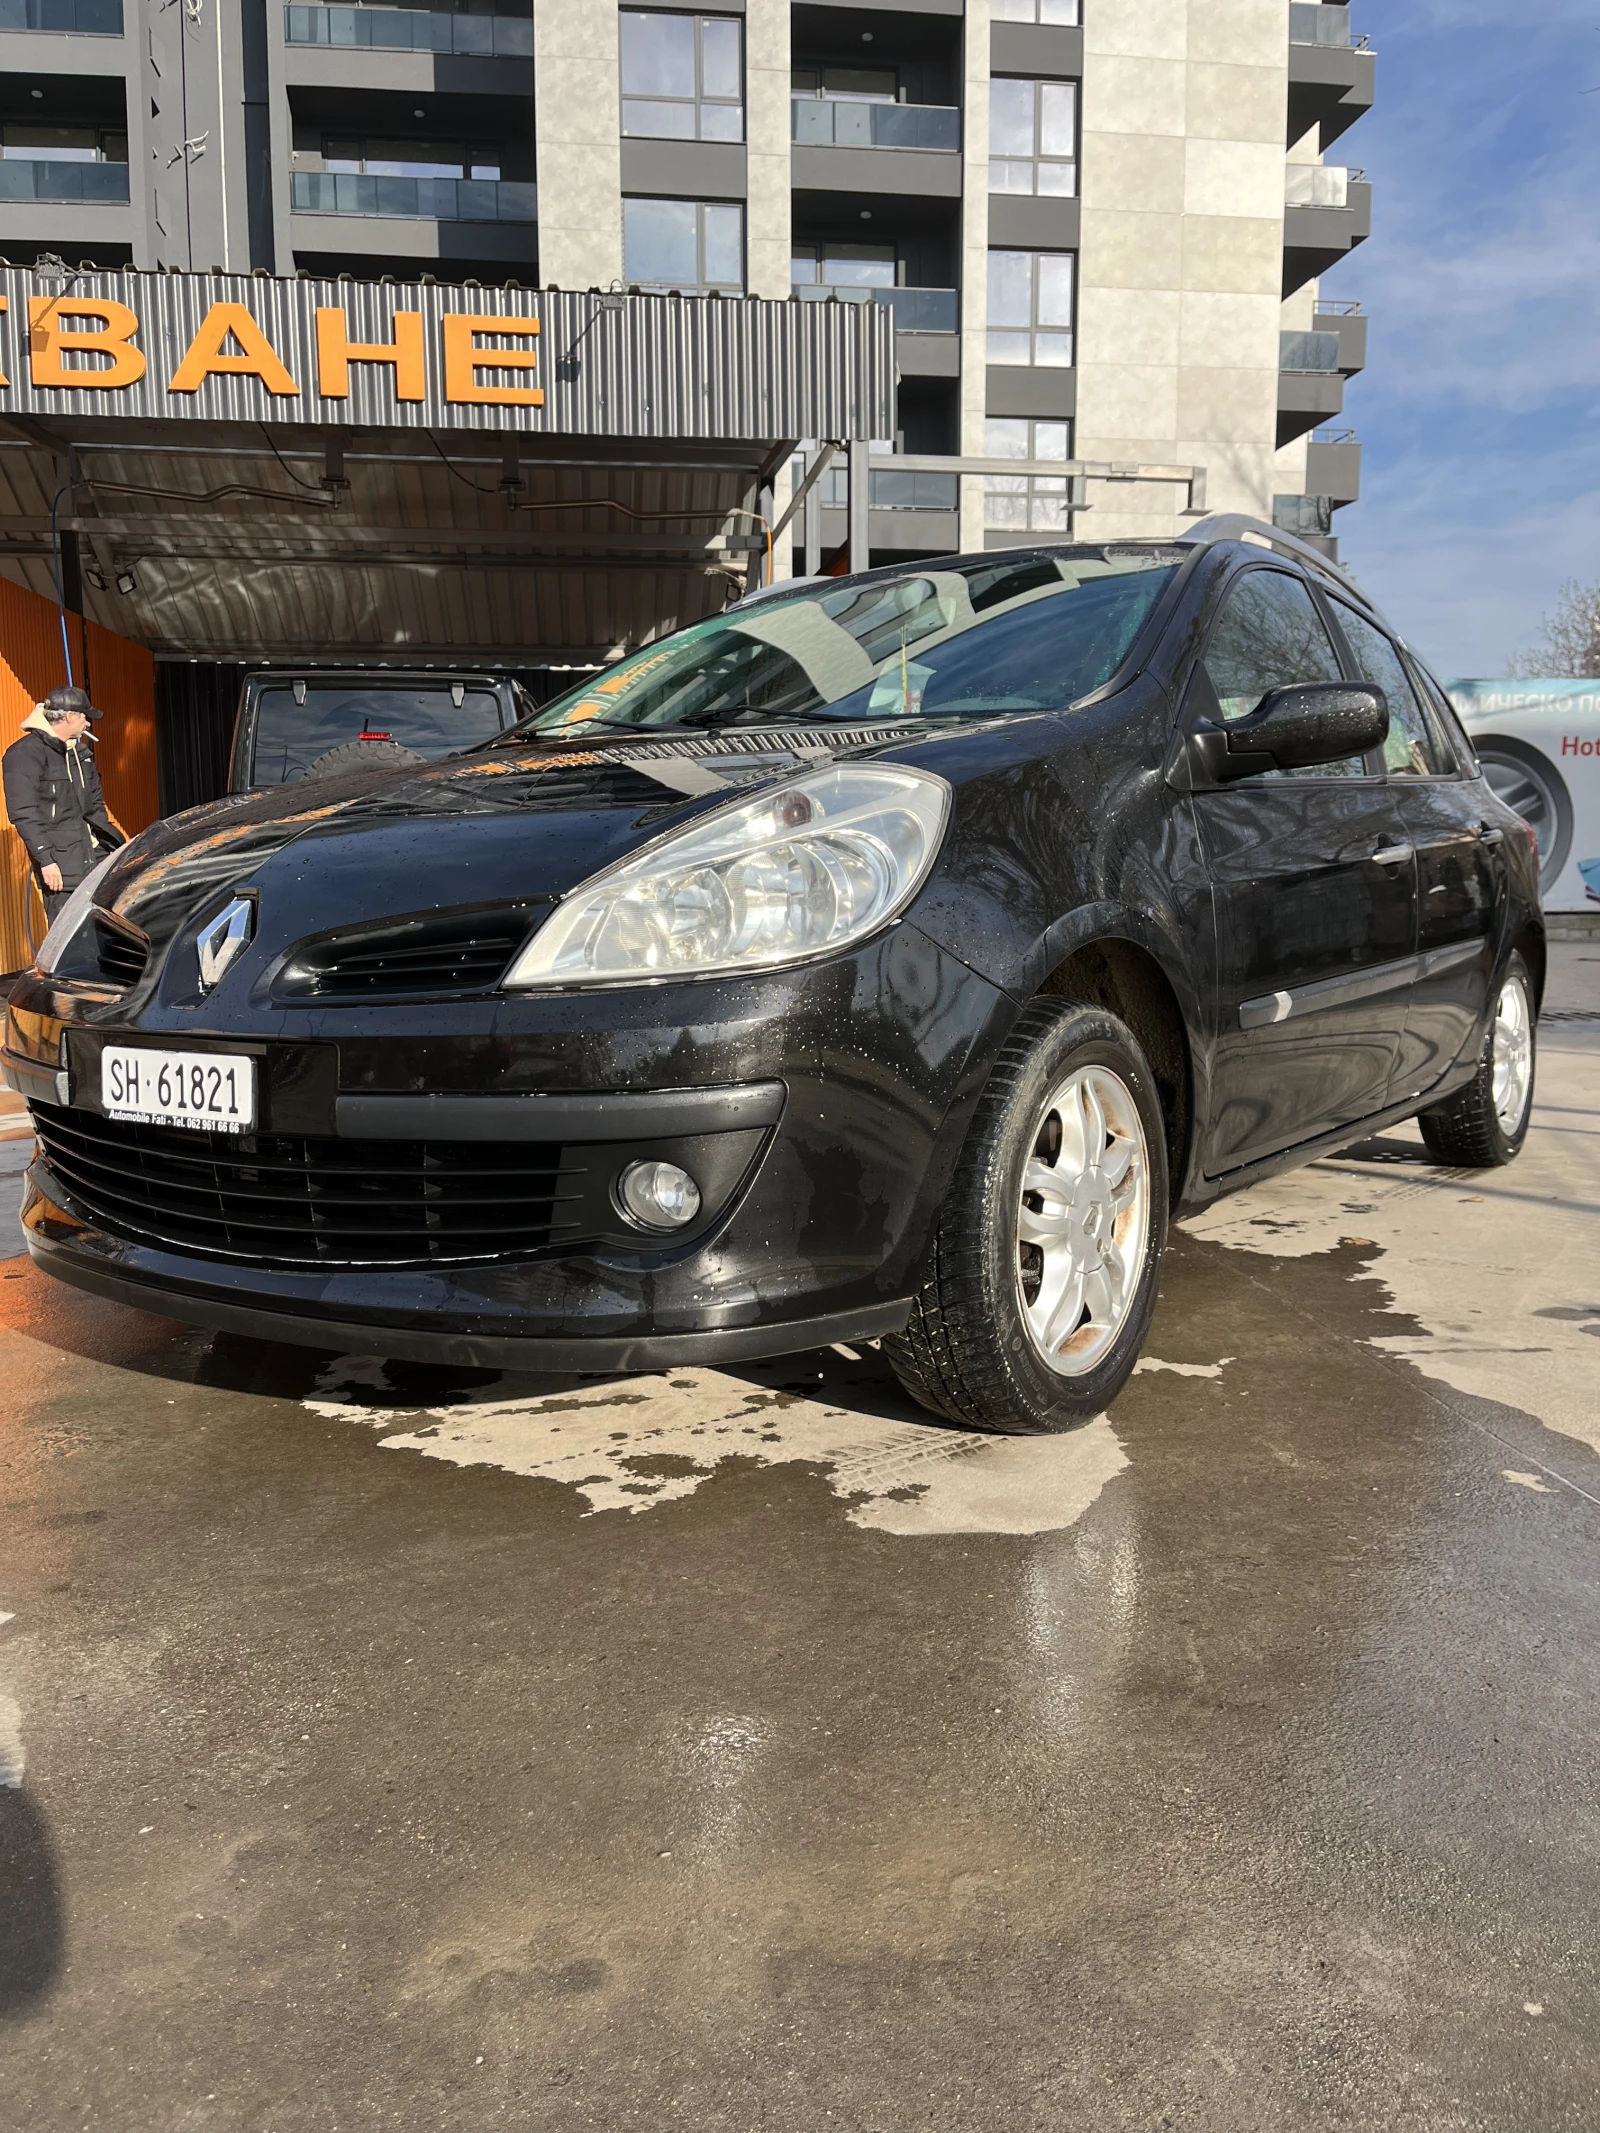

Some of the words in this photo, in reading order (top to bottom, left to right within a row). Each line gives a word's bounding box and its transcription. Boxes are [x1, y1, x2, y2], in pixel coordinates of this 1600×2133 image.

[0, 295, 544, 406] ВАНЕ
[108, 1109, 150, 1123] Automobile
[151, 1113, 167, 1125] Fati
[172, 1116, 186, 1128] Tel.
[186, 1117, 201, 1130] 062
[201, 1119, 216, 1131] 961
[217, 1121, 228, 1133] 66
[228, 1122, 240, 1134] 66
